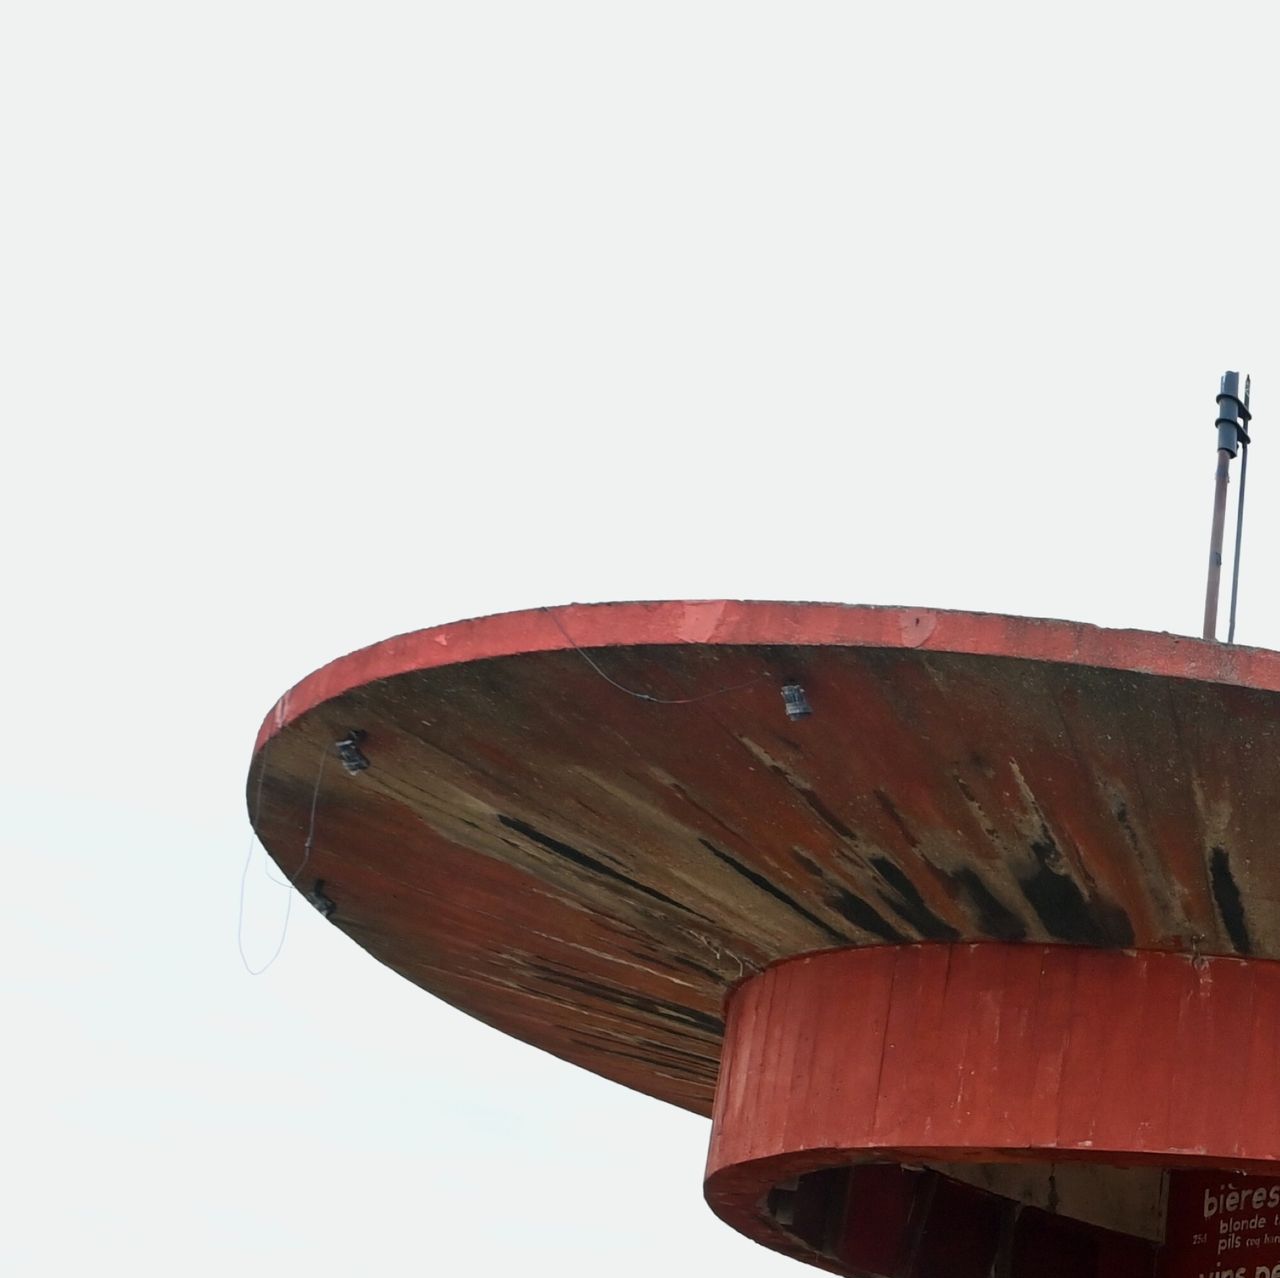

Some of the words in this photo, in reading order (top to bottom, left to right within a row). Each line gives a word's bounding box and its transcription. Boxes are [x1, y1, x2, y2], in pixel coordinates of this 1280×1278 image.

[1203, 1183, 1280, 1217] bières
[1220, 1214, 1266, 1234] blonde
[1217, 1232, 1241, 1255] pils
